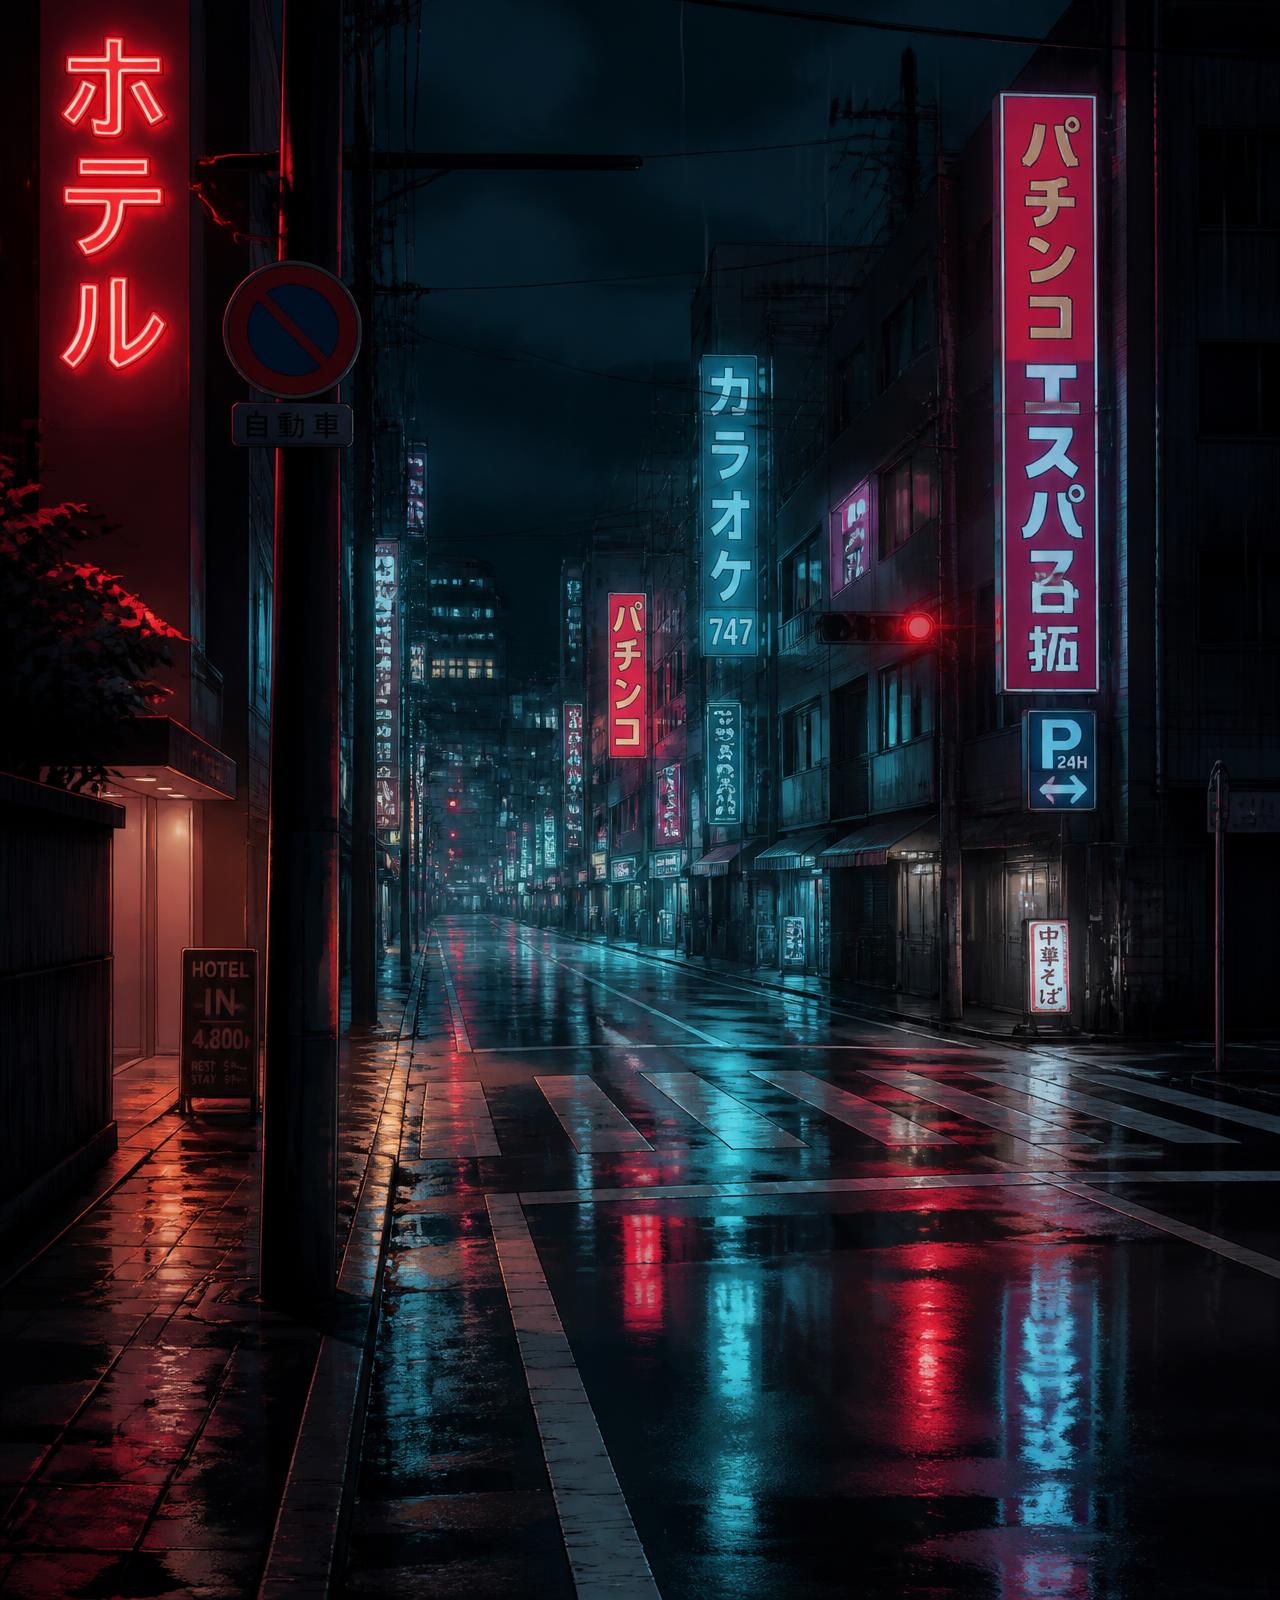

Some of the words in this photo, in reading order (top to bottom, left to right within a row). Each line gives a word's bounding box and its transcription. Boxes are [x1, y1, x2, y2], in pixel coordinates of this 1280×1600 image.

[61, 37, 168, 370] ホテル
[1021, 115, 1081, 339] パチンコ
[246, 411, 339, 439] 自動車
[710, 367, 751, 602] カラオケ
[709, 617, 752, 646] 747
[613, 601, 643, 746] パチンコ
[1041, 719, 1082, 769] P
[1057, 755, 1088, 769] 24H
[192, 960, 249, 979] HOTEL
[1039, 926, 1063, 1004] 中華そば
[204, 987, 236, 1017] IN
[191, 1060, 217, 1073] REST
